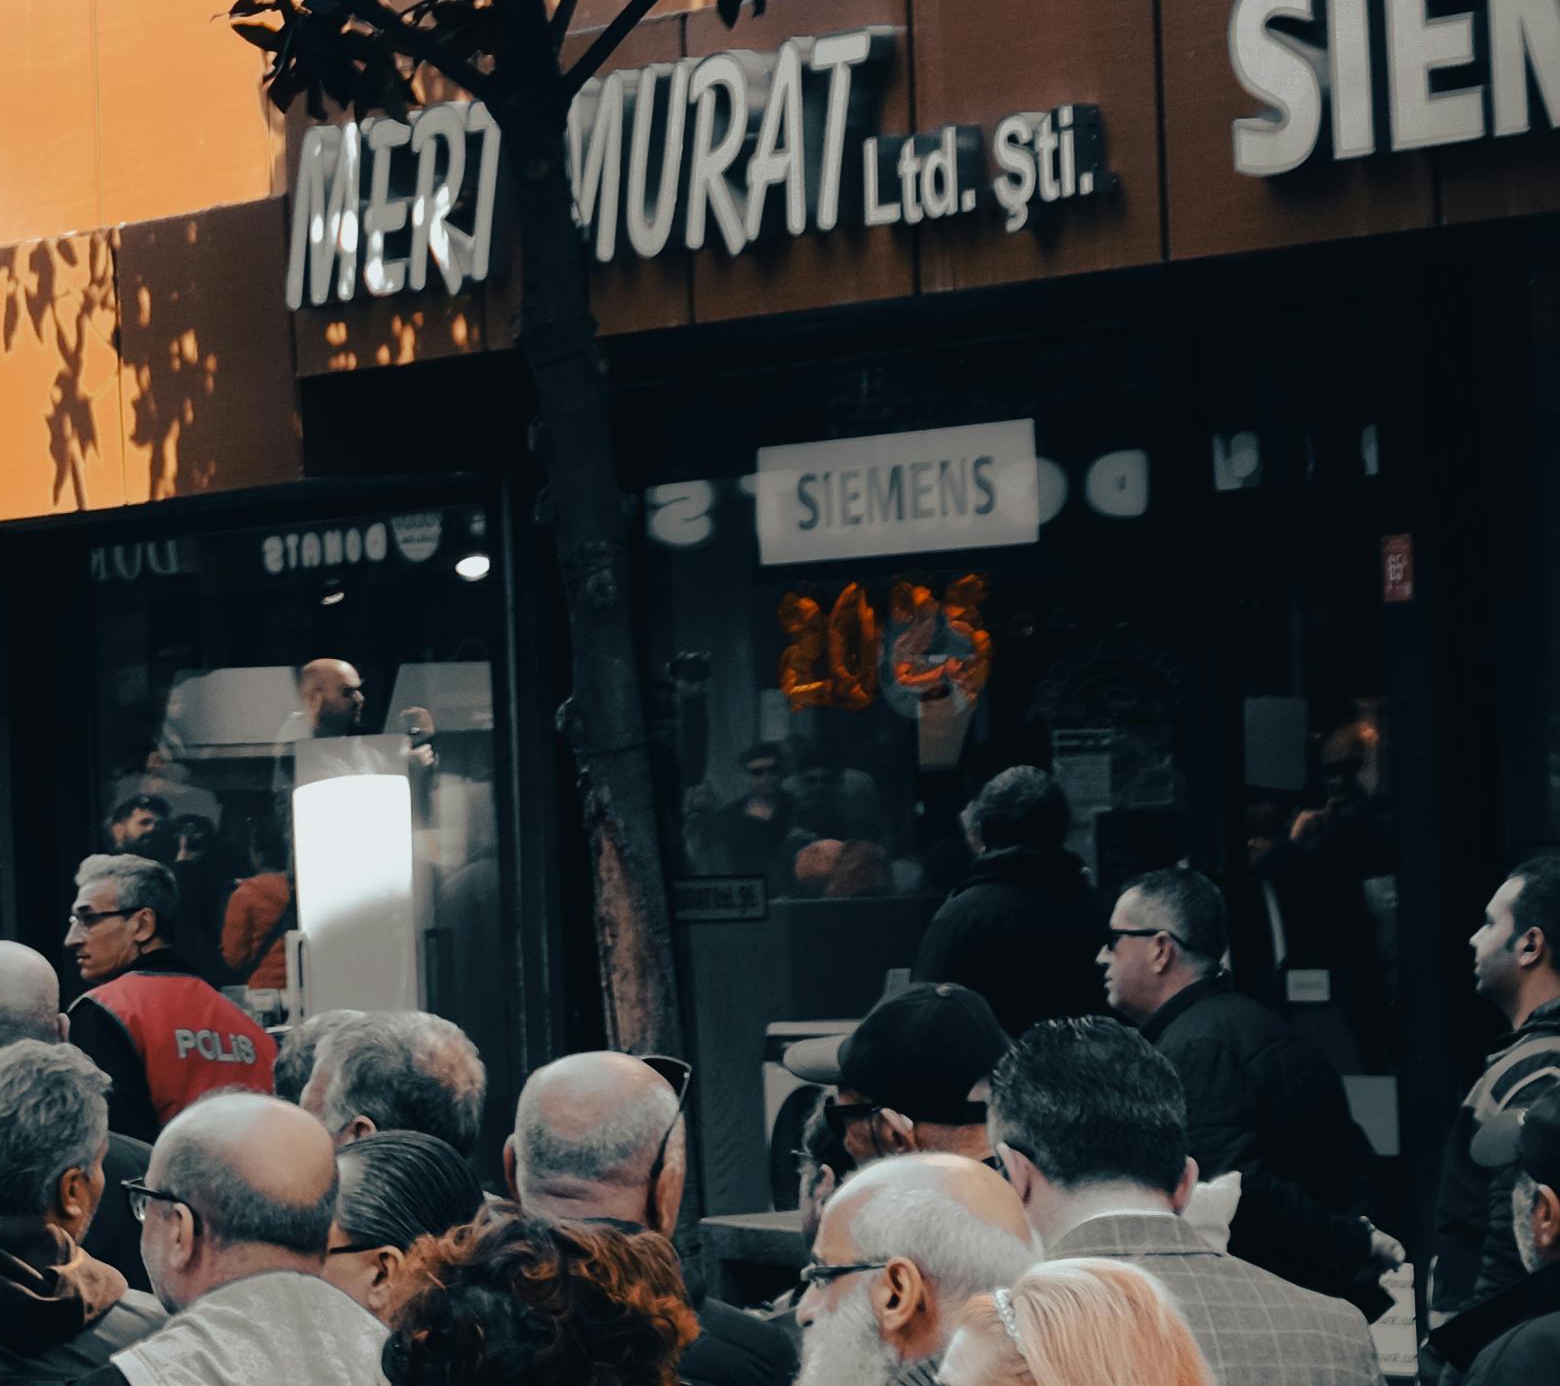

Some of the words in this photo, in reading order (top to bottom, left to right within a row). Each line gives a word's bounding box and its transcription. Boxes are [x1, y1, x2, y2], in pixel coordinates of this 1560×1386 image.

[566, 28, 872, 264] MURAT
[863, 124, 976, 227] Ltd.
[993, 104, 1095, 233] Şti.
[797, 455, 997, 531] SIEMENS
